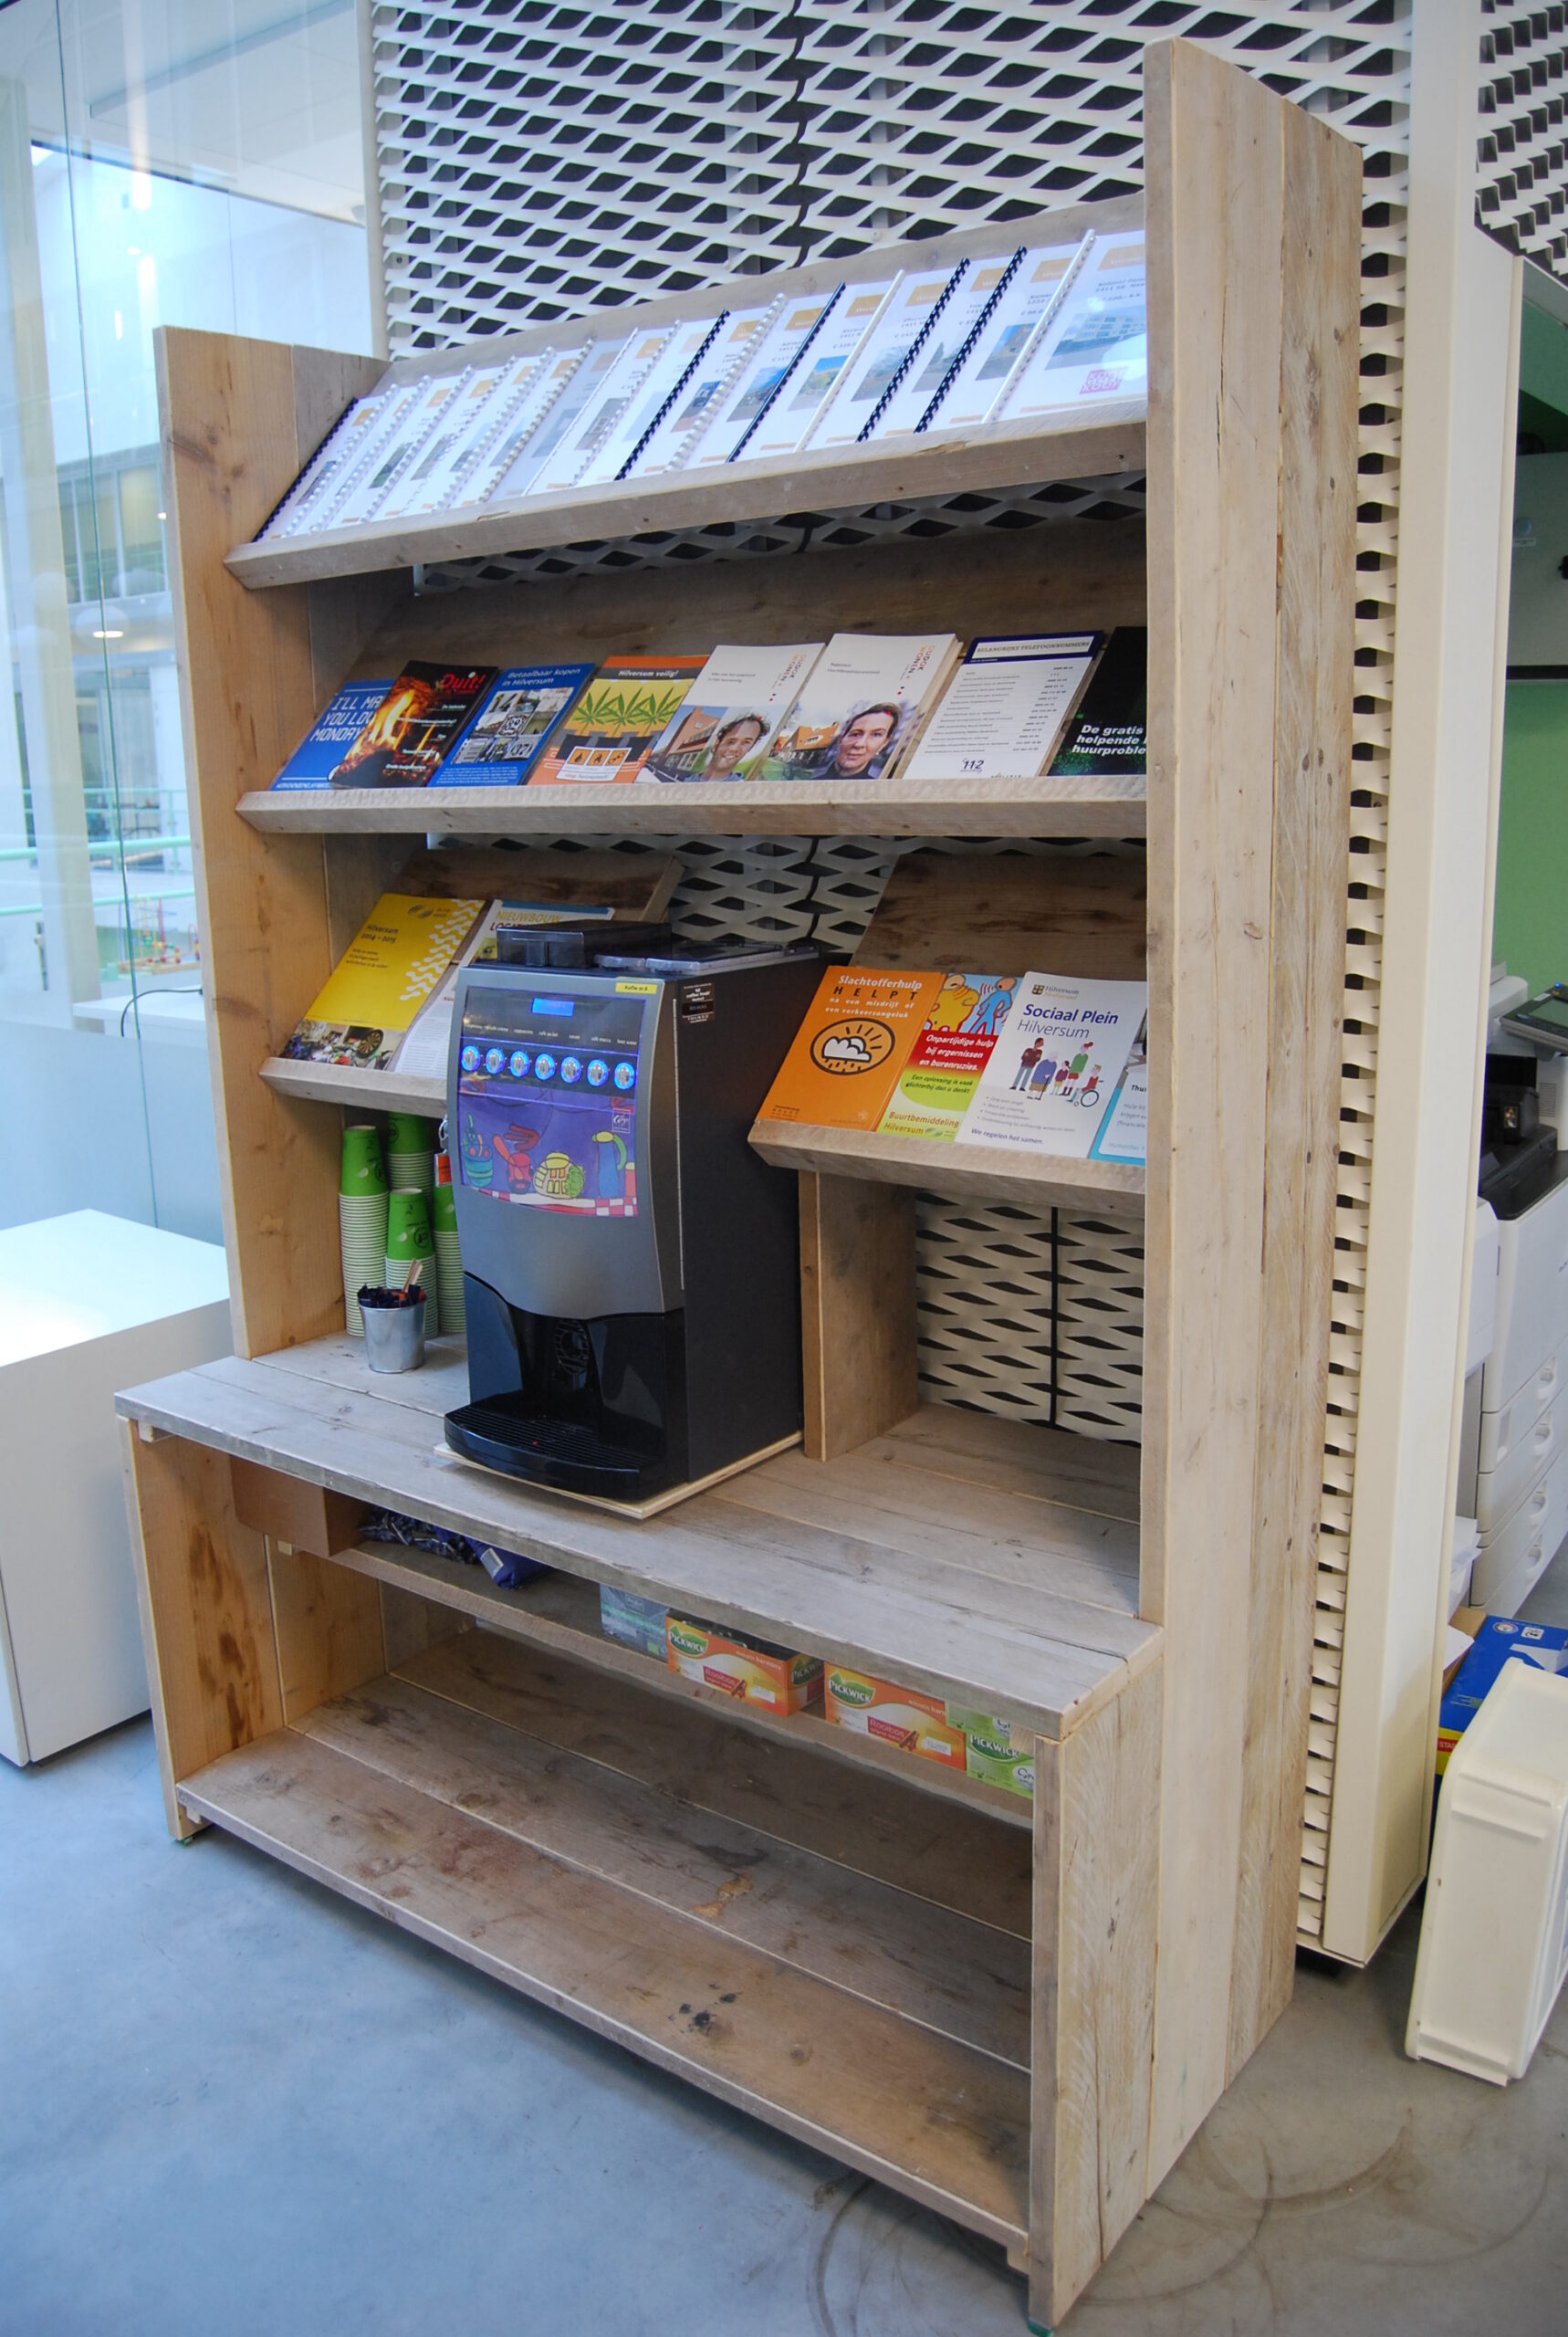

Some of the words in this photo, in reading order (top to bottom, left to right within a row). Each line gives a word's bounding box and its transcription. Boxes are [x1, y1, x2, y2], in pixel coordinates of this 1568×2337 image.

[1021, 641, 1090, 650] TELEFOONNUMMERS
[553, 668, 581, 676] kopen
[618, 669, 653, 677] Hilversum
[656, 670, 679, 678] veilig!
[511, 677, 554, 686] Hilversum
[331, 696, 357, 710] I'LL
[361, 695, 386, 709] MA
[323, 712, 348, 726] YOU
[347, 711, 374, 725] LOV
[1082, 725, 1100, 734] De
[1103, 726, 1144, 736] gratis
[1076, 734, 1140, 746] helpende
[1071, 744, 1146, 757] huurproble
[963, 759, 985, 770] 112
[497, 911, 561, 923] NIEUWBOUW
[839, 975, 923, 991] Slachtofferhulp
[866, 1000, 899, 1009] misdrijf
[1023, 1003, 1079, 1022] Sociaal
[1082, 1010, 1119, 1024] Plein
[1017, 1019, 1090, 1039] Hilversum
[926, 1034, 975, 1046] Onpartijdige
[975, 1039, 994, 1049] hulp
[925, 1046, 937, 1056] bij
[937, 1048, 984, 1059] ergernissen
[930, 1060, 978, 1071] burenruzies.
[924, 1075, 952, 1085] oplossing
[888, 1111, 960, 1129] Buurtbemiddeling
[883, 1122, 924, 1135] Hilversum
[983, 1130, 1008, 1139] regelen
[668, 1630, 706, 1653] PICKWICK
[829, 1679, 872, 1703] PICKWICK
[870, 1718, 905, 1738] Rooibos
[969, 1734, 1021, 1759] PICKWICK
